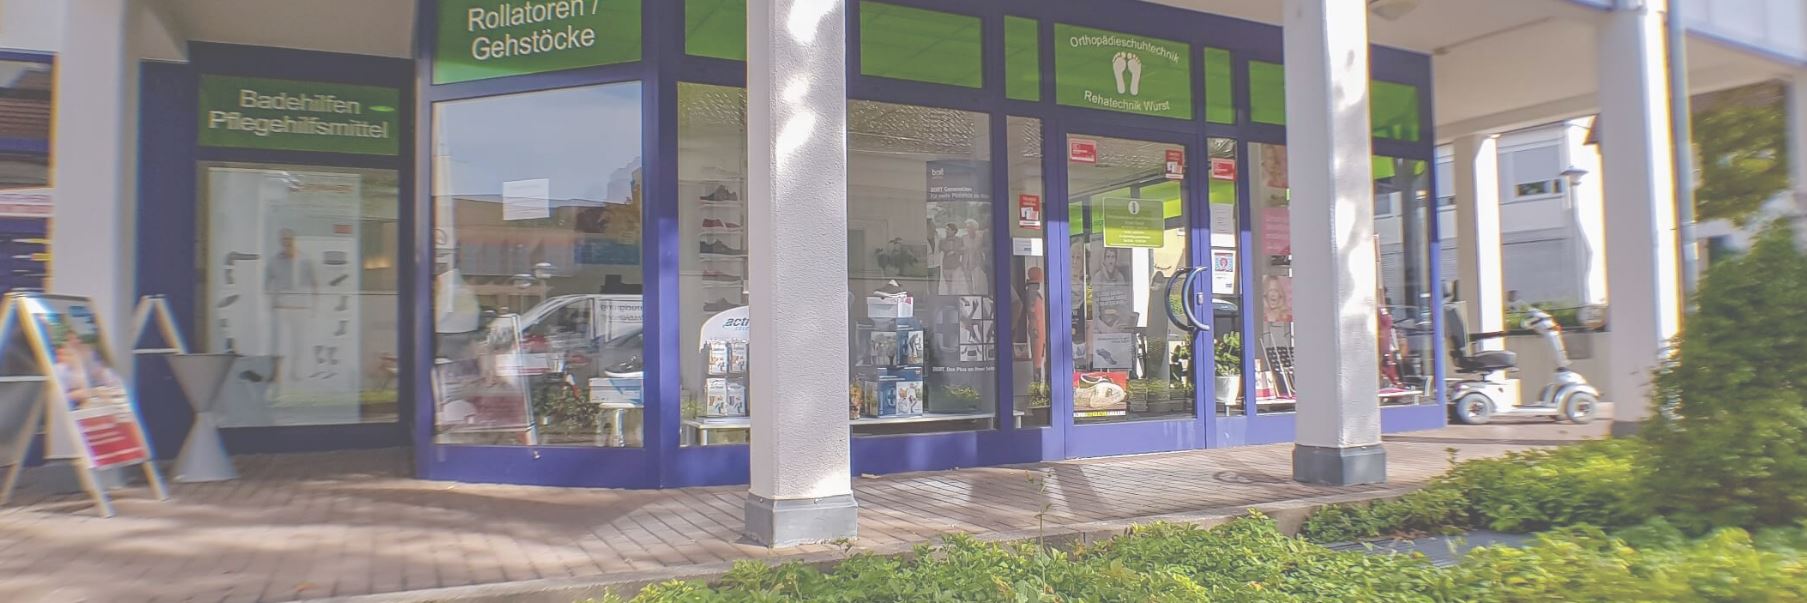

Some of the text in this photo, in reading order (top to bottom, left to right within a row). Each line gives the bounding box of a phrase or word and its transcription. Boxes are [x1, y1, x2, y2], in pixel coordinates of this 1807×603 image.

[468, 0, 584, 32] Rollatoren
[472, 25, 596, 60] Gehstöcke
[1069, 34, 1180, 63] Orthopädieschuhtechnik
[239, 88, 361, 115] Badehilfen
[1083, 90, 1170, 112] Rehatechnik Wurst
[207, 109, 390, 139] Pflegehilfsmittel
